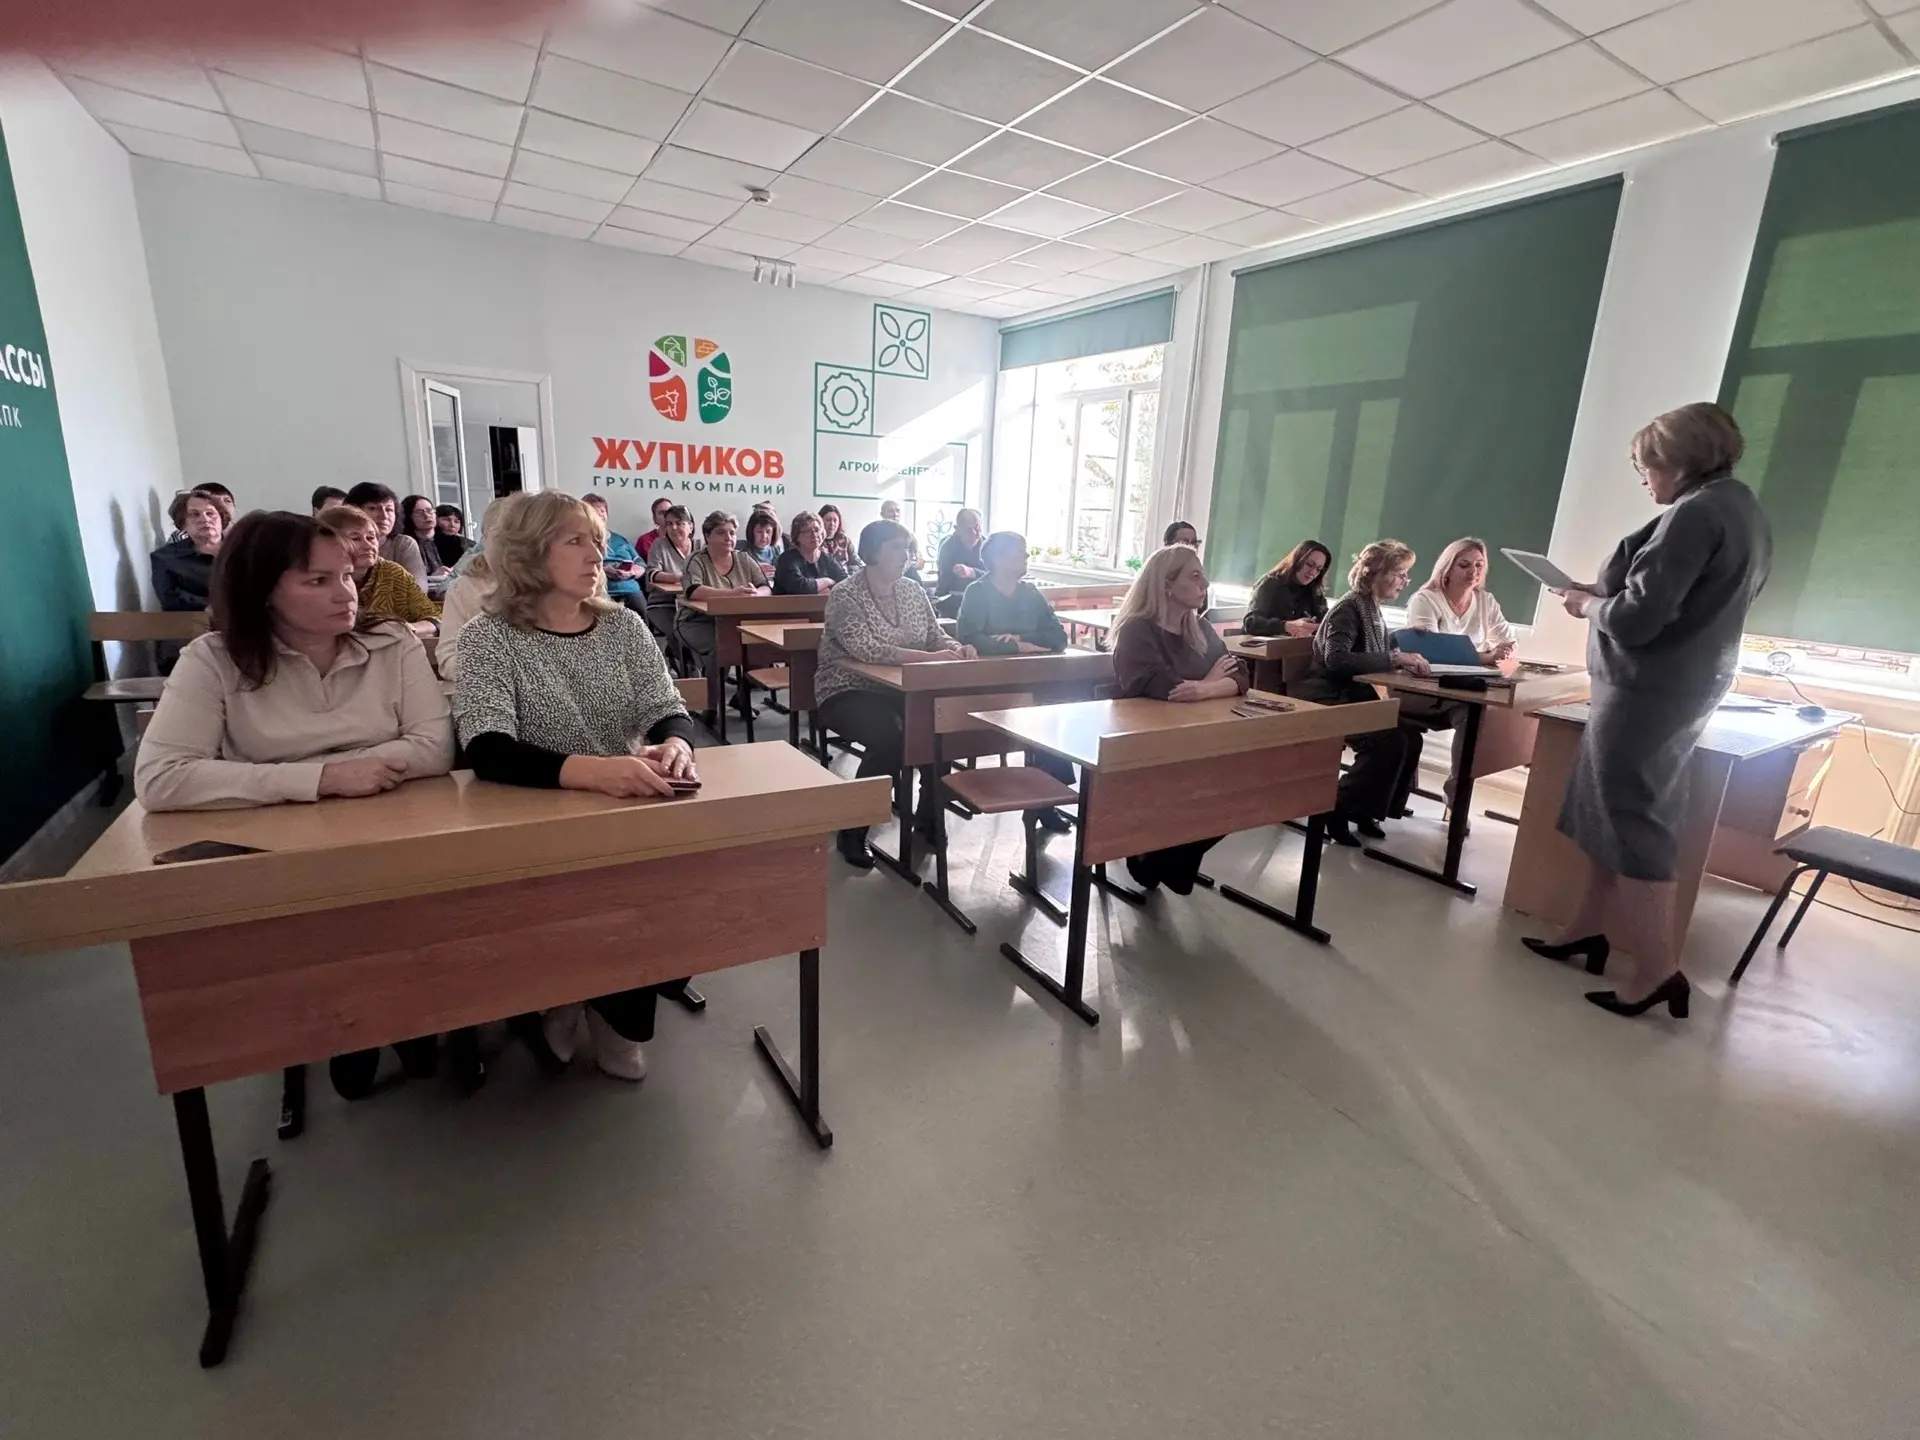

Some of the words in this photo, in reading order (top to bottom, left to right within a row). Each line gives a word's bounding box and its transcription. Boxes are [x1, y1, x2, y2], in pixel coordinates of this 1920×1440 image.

[592, 437, 784, 479] ЖУПИКОВ
[593, 476, 674, 491] ГРУППА
[681, 480, 786, 496] КОМПАНИЙ
